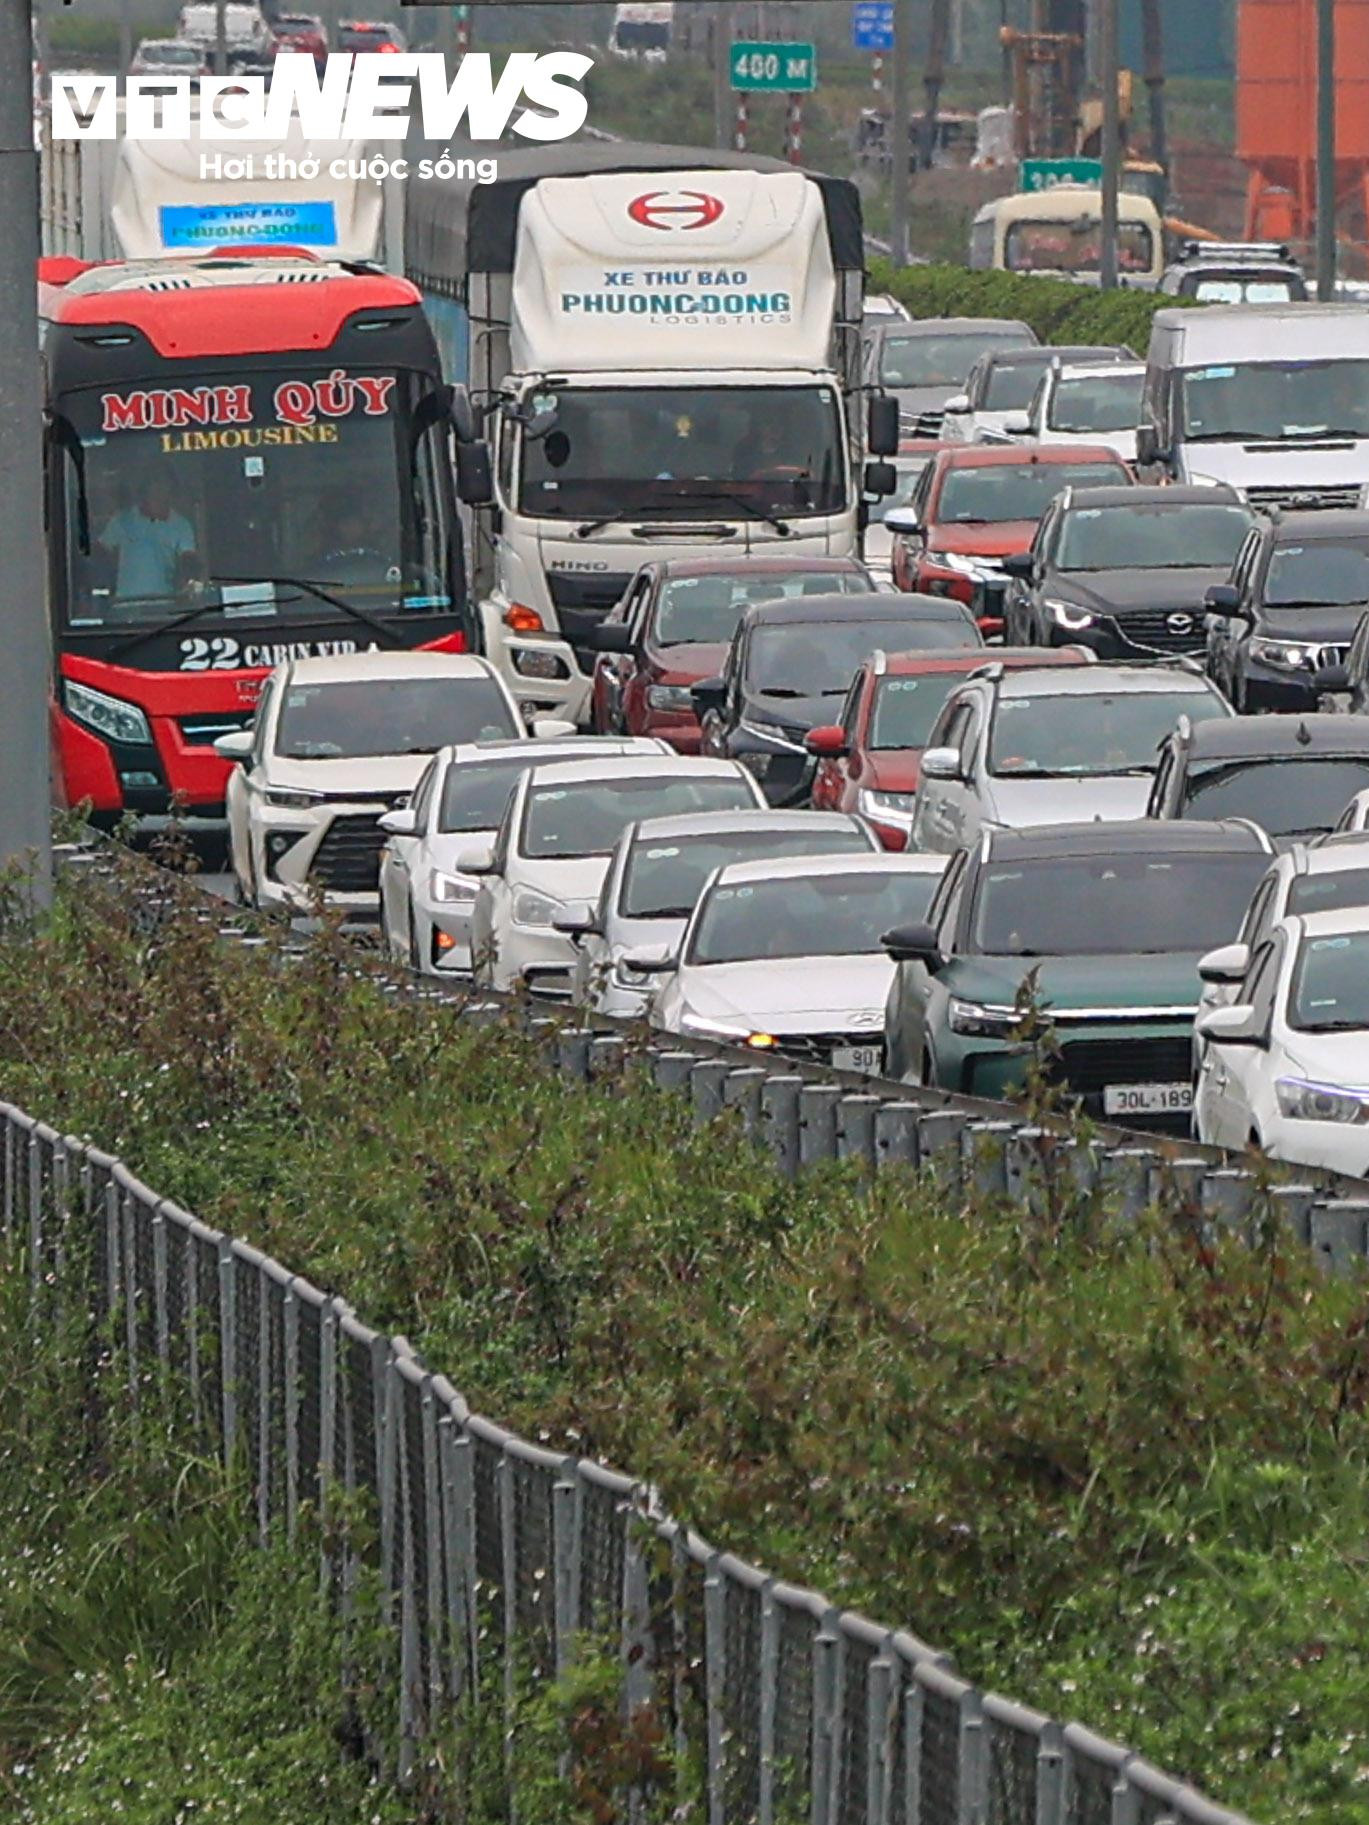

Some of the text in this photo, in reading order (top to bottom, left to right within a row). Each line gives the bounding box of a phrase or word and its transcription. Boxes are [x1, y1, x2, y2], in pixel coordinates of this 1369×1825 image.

[735, 53, 809, 80] 400 M
[603, 271, 634, 286] XE
[643, 270, 691, 286] THƯ
[650, 314, 793, 325] LOGISTICS
[101, 384, 254, 432] MINH
[160, 424, 340, 453] LIMOUSINE
[552, 560, 608, 571] HINO
[180, 637, 241, 671] 22
